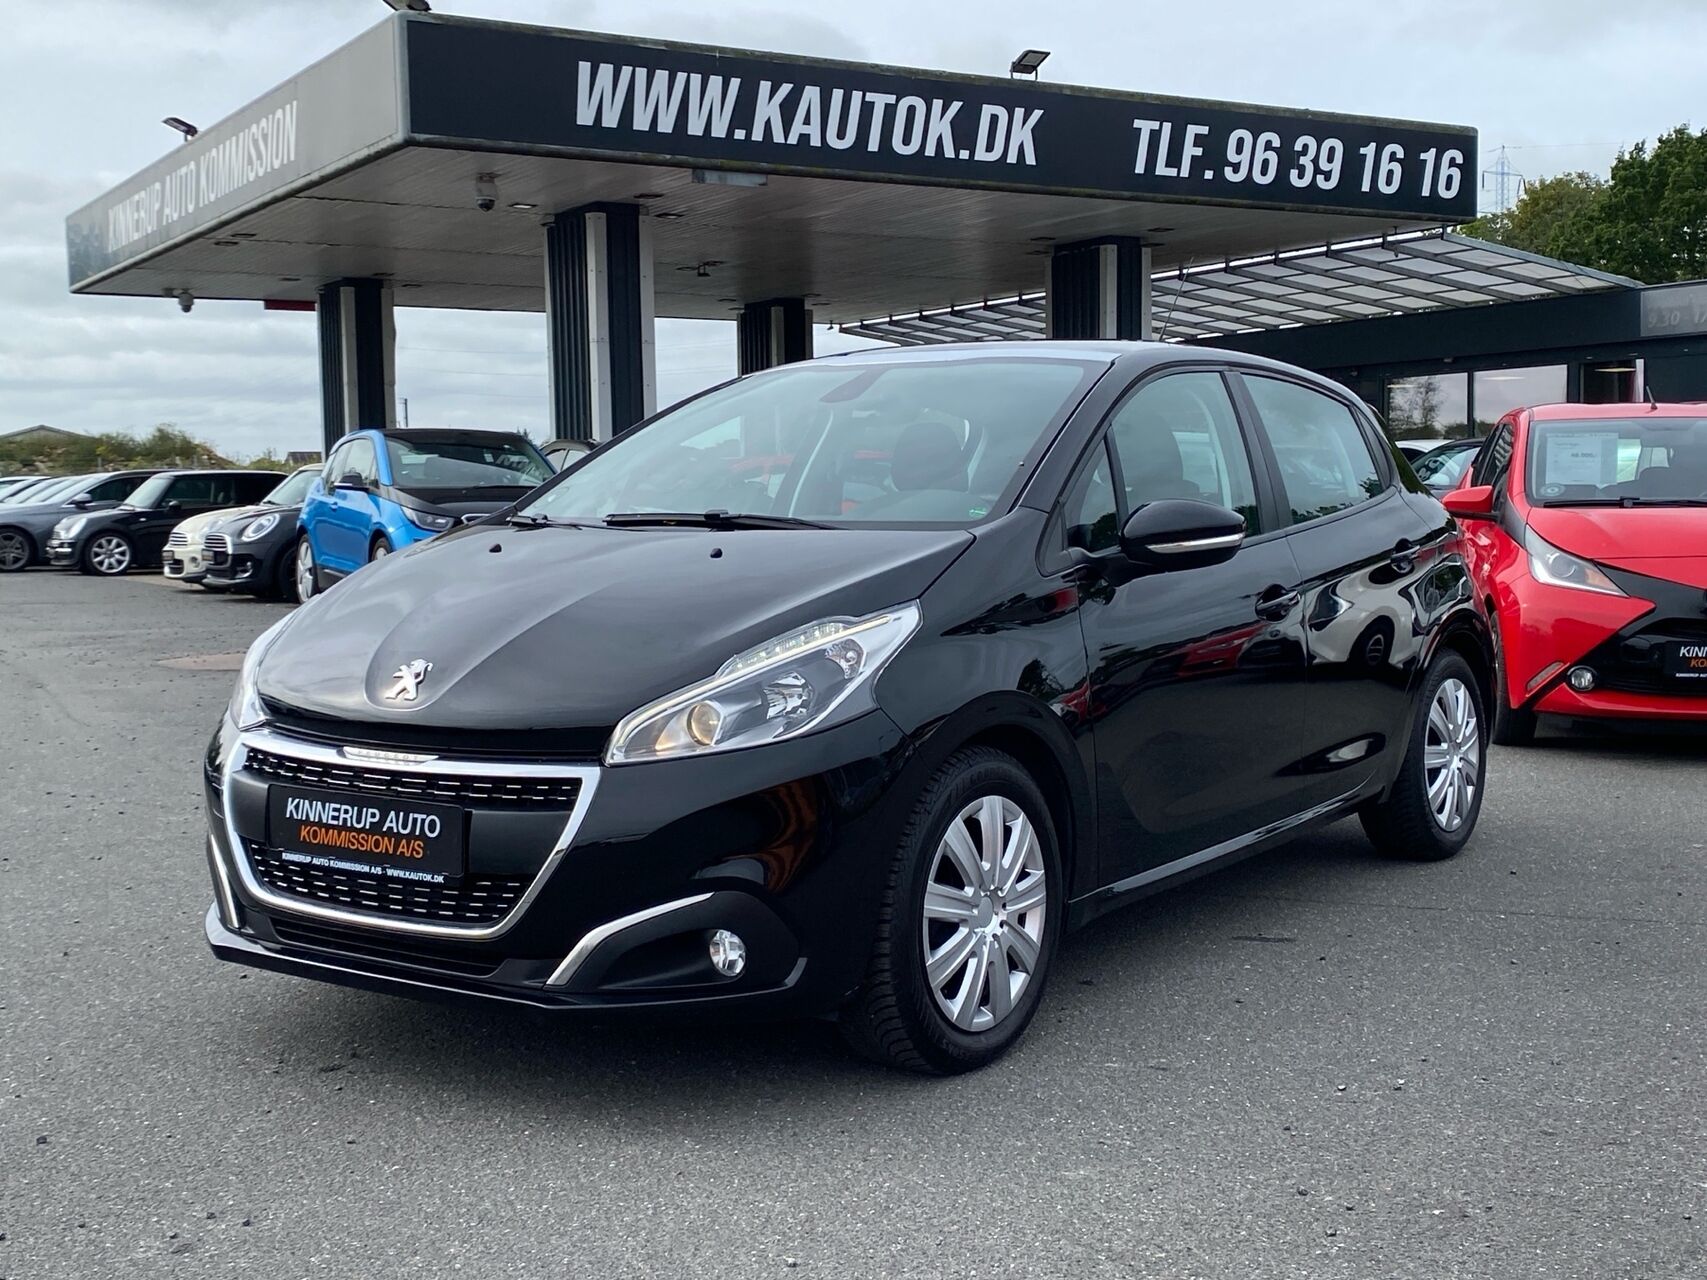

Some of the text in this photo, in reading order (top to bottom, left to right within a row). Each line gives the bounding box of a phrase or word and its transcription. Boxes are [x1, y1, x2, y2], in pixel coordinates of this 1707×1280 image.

[576, 60, 1044, 166] WWW.KAUTOK.DK
[108, 100, 298, 253] KINNERUP AUTO KOMMISSION
[1132, 119, 1464, 199] TLF. 96 39 16 16
[285, 797, 441, 838] KINNERUP AUTO
[300, 825, 424, 859] KOMMISSION A/S
[312, 857, 329, 867] AUTO
[329, 860, 370, 873] KOMMISSION
[370, 865, 382, 875] A/S
[386, 869, 445, 883] WWW.KAUTOK.DK
